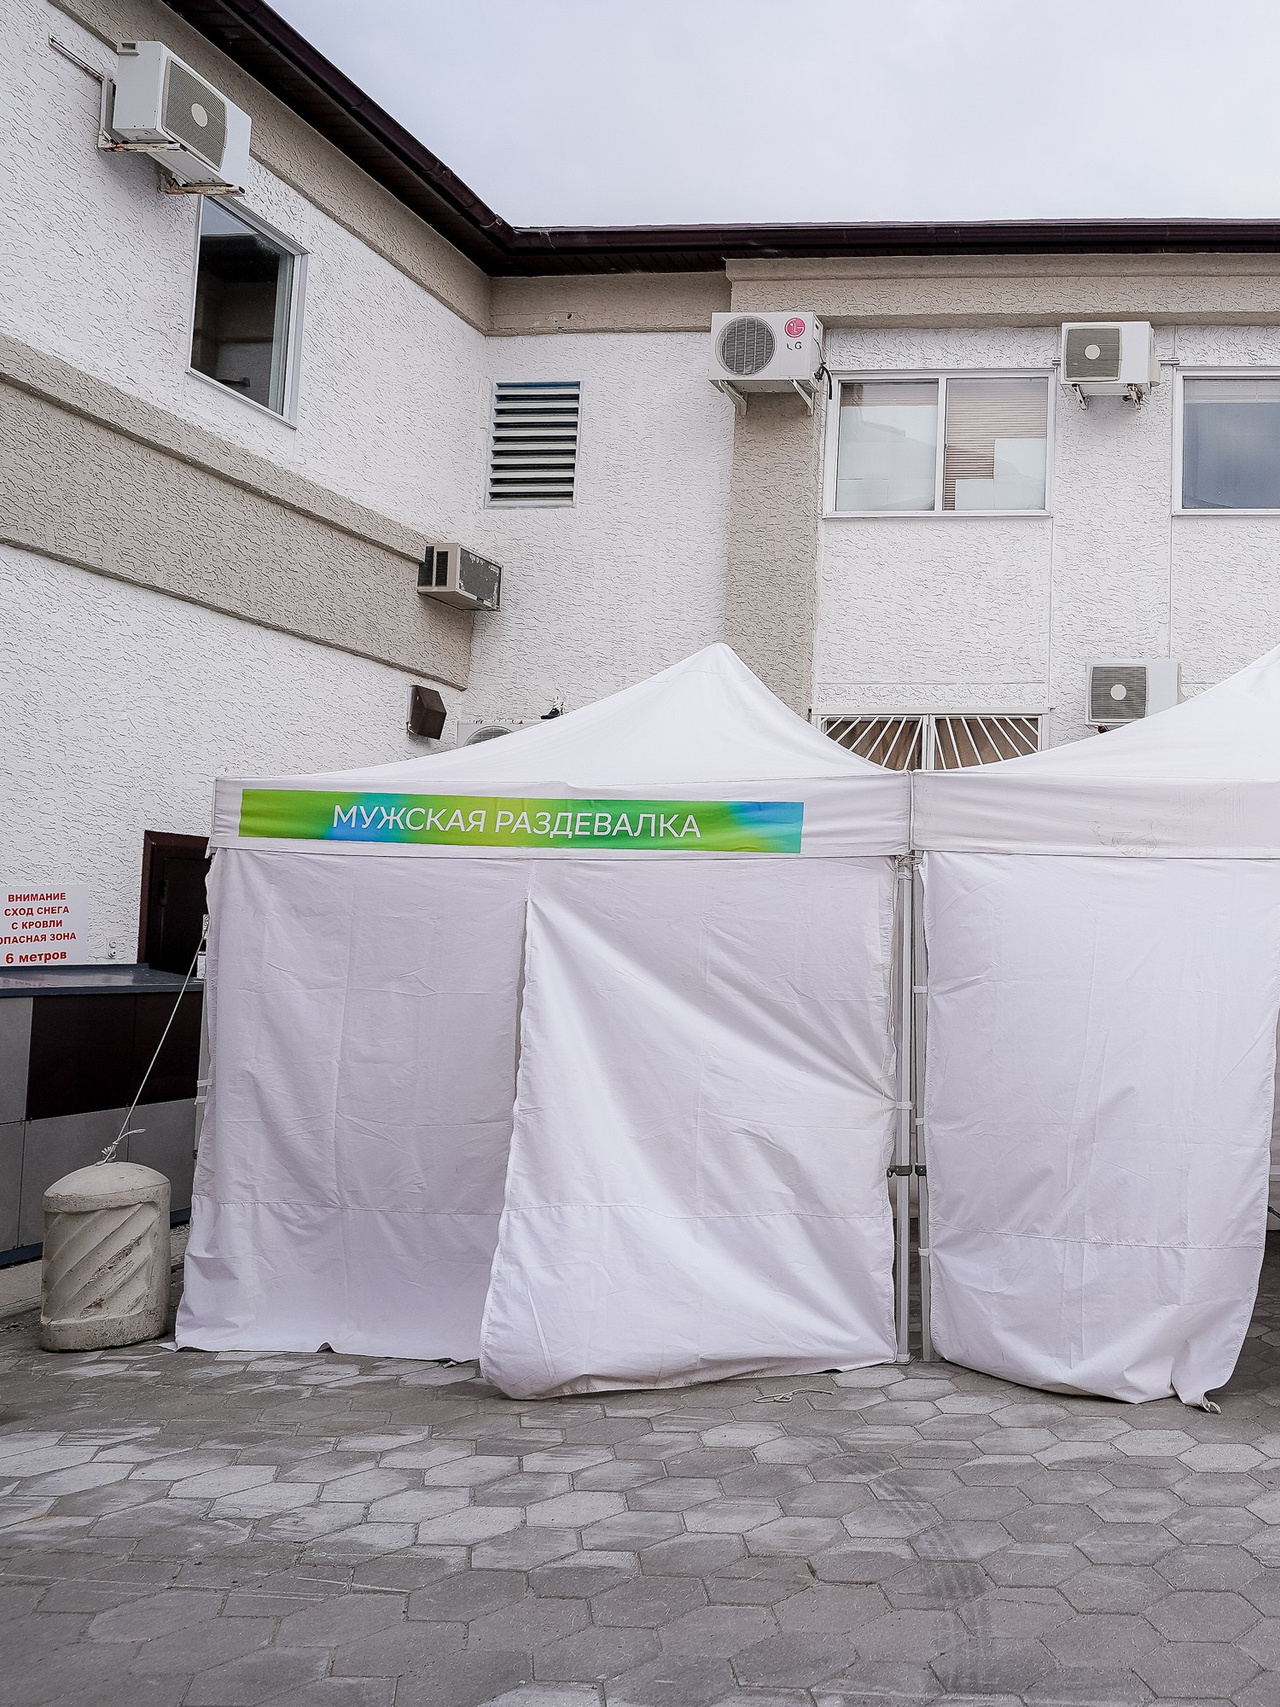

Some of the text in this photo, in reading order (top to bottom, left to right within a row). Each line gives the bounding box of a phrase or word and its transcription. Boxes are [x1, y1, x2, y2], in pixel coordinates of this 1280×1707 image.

[786, 341, 802, 351] LG
[332, 804, 702, 839] МУЖСКАЯ РАЗДЕВАЛКА
[8, 892, 66, 902] ВНИМАНИЕ
[4, 905, 69, 917] СХОД СНЕГА
[11, 919, 63, 930] С КРОВЛИ
[49, 932, 76, 942] ЗОНА
[5, 951, 67, 964] 6 метров
